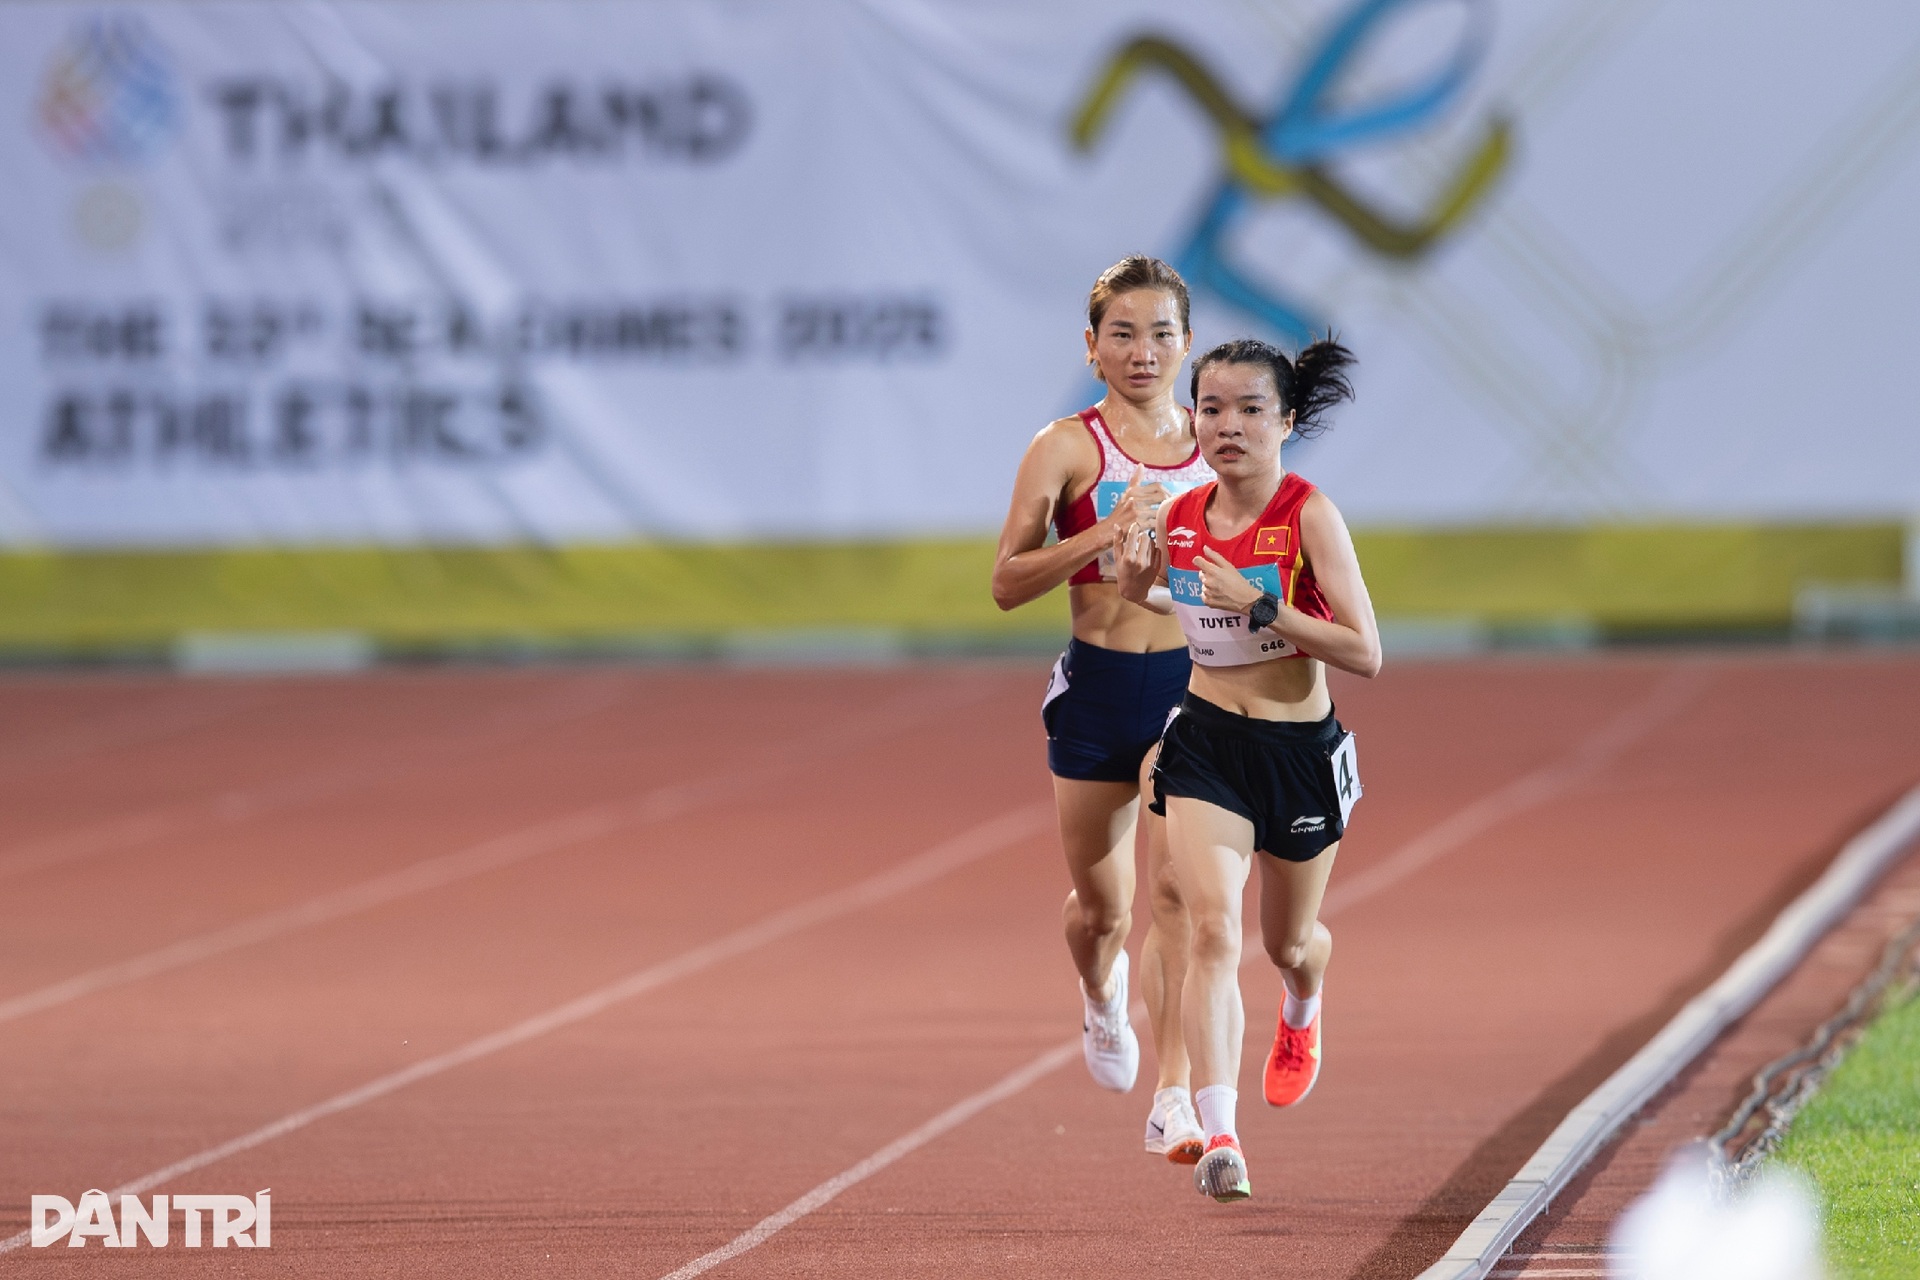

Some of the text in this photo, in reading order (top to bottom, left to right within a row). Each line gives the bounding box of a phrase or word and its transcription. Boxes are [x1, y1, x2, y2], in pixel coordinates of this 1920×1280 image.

[211, 74, 755, 164] THAILAND
[43, 385, 542, 468] ATHLETICS
[1187, 581, 1201, 597] SE
[1199, 615, 1241, 628] TUYET
[1261, 639, 1285, 652] 646
[1340, 750, 1353, 800] 4
